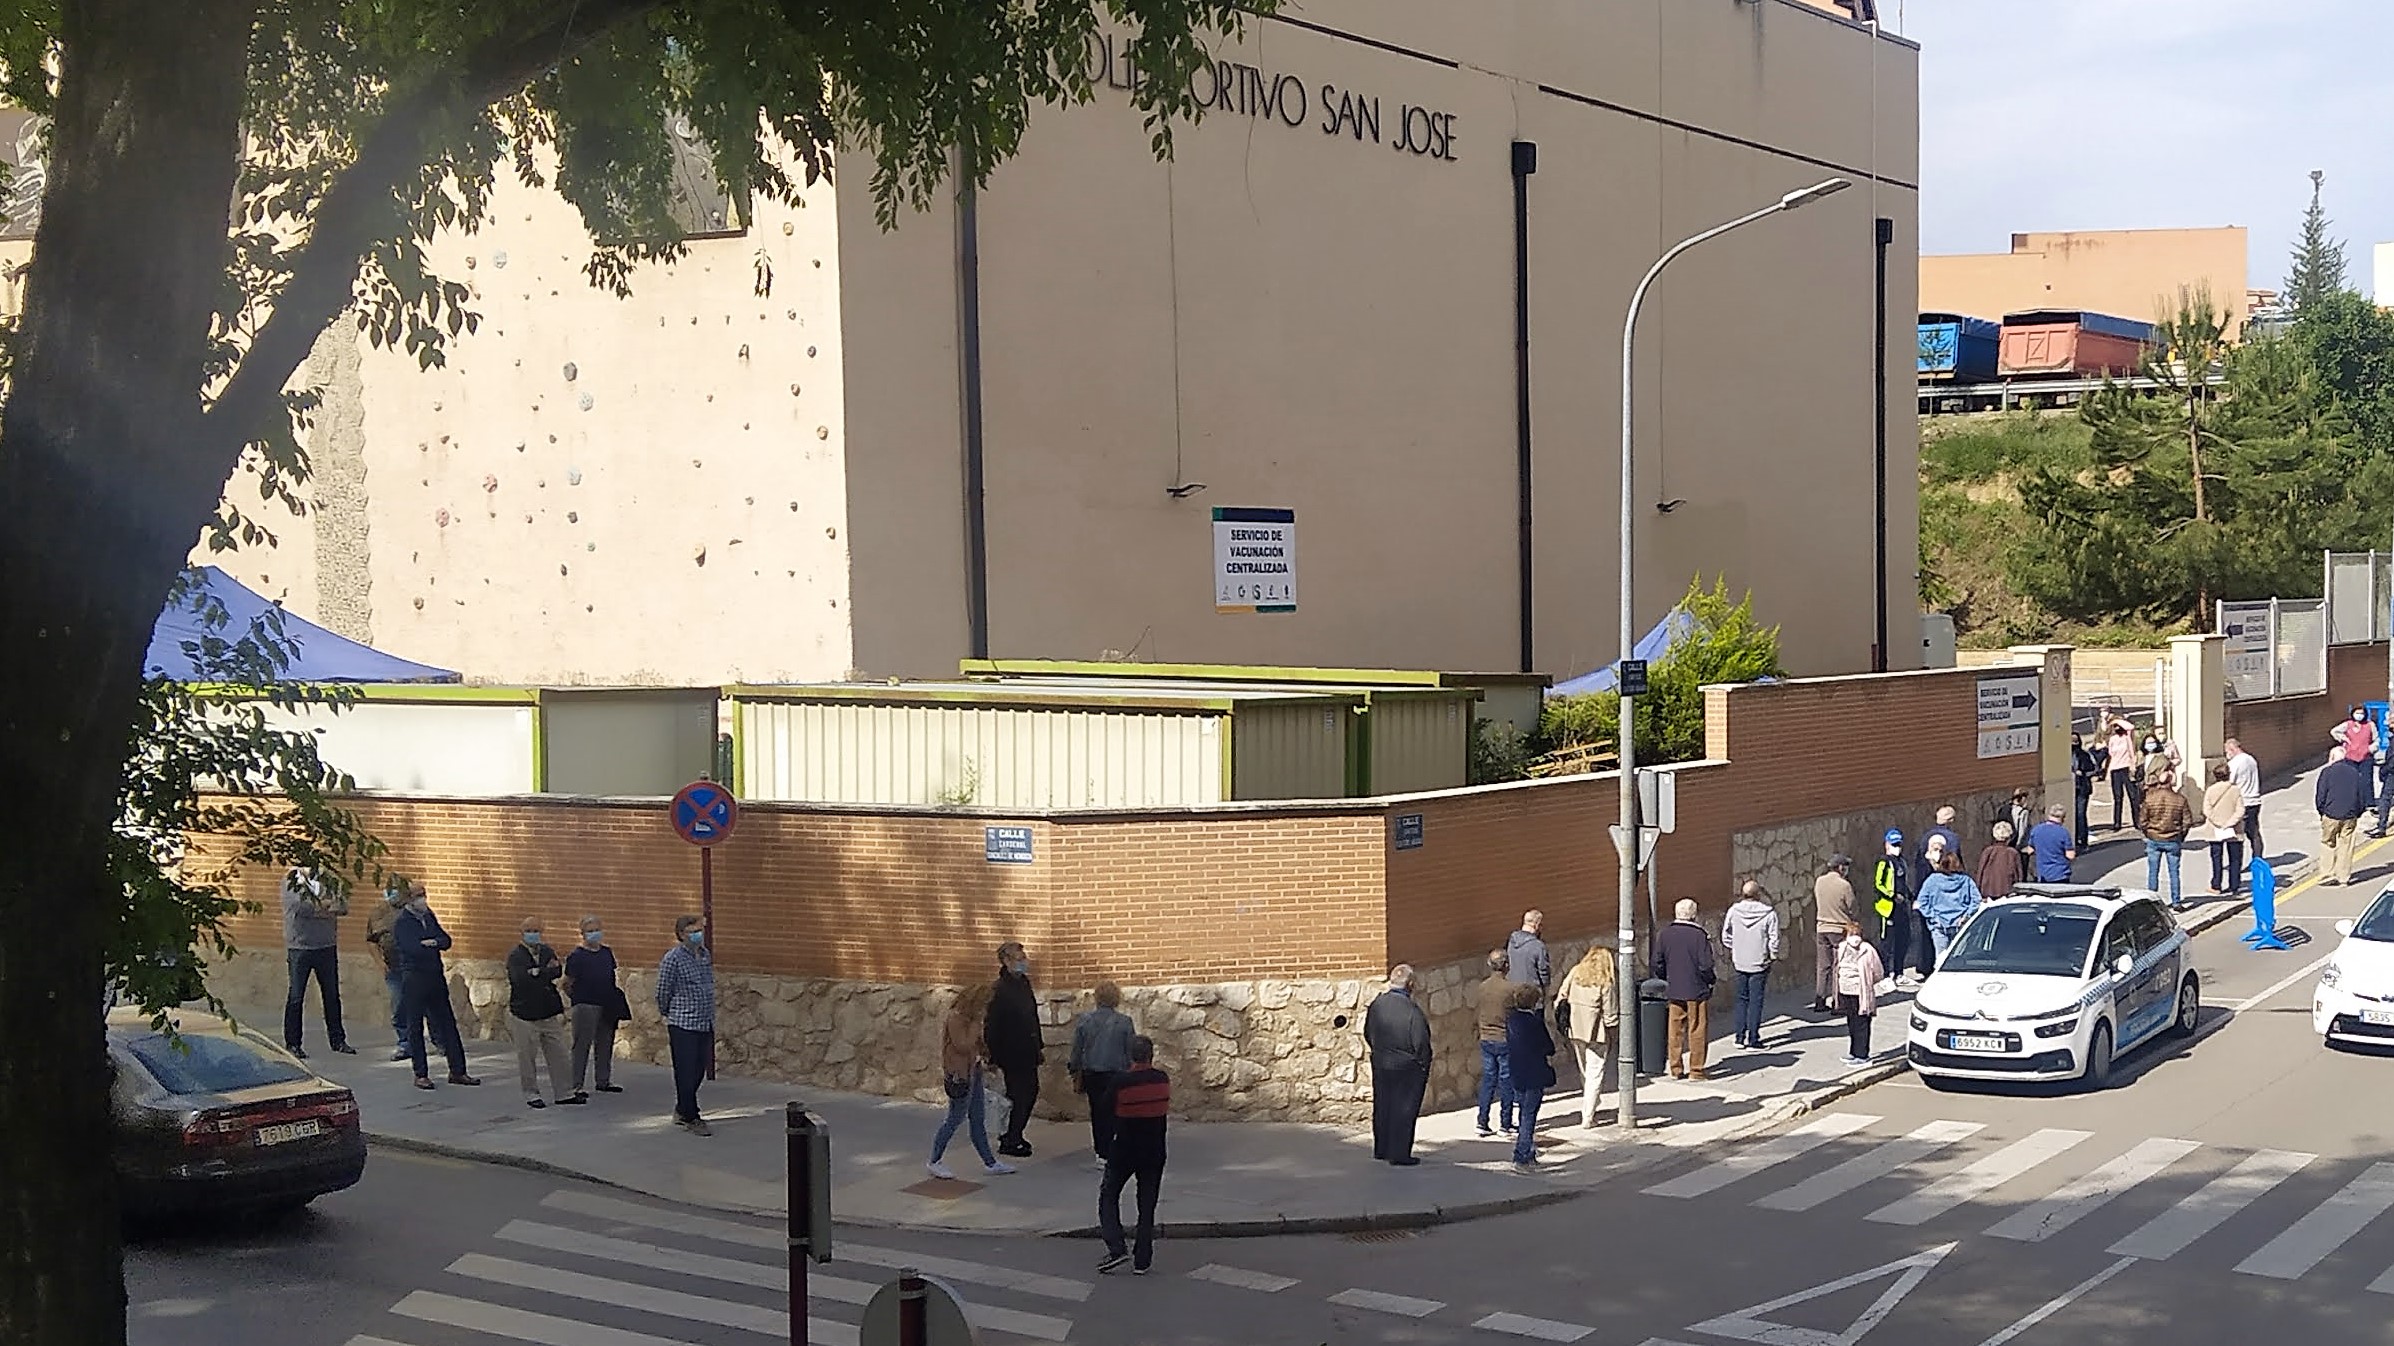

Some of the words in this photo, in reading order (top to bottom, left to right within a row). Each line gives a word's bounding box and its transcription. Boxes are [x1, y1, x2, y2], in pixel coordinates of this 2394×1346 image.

[1321, 84, 1381, 145] SAN
[1393, 104, 1459, 161] JOSE
[1230, 529, 1269, 541] SERVICIO
[1271, 530, 1283, 541] DE
[1229, 544, 1284, 558] VACUNACIÓN
[1226, 562, 1289, 574] CENTRALIZADA
[998, 829, 1026, 839] CALLE
[1957, 1037, 1982, 1048] 6952
